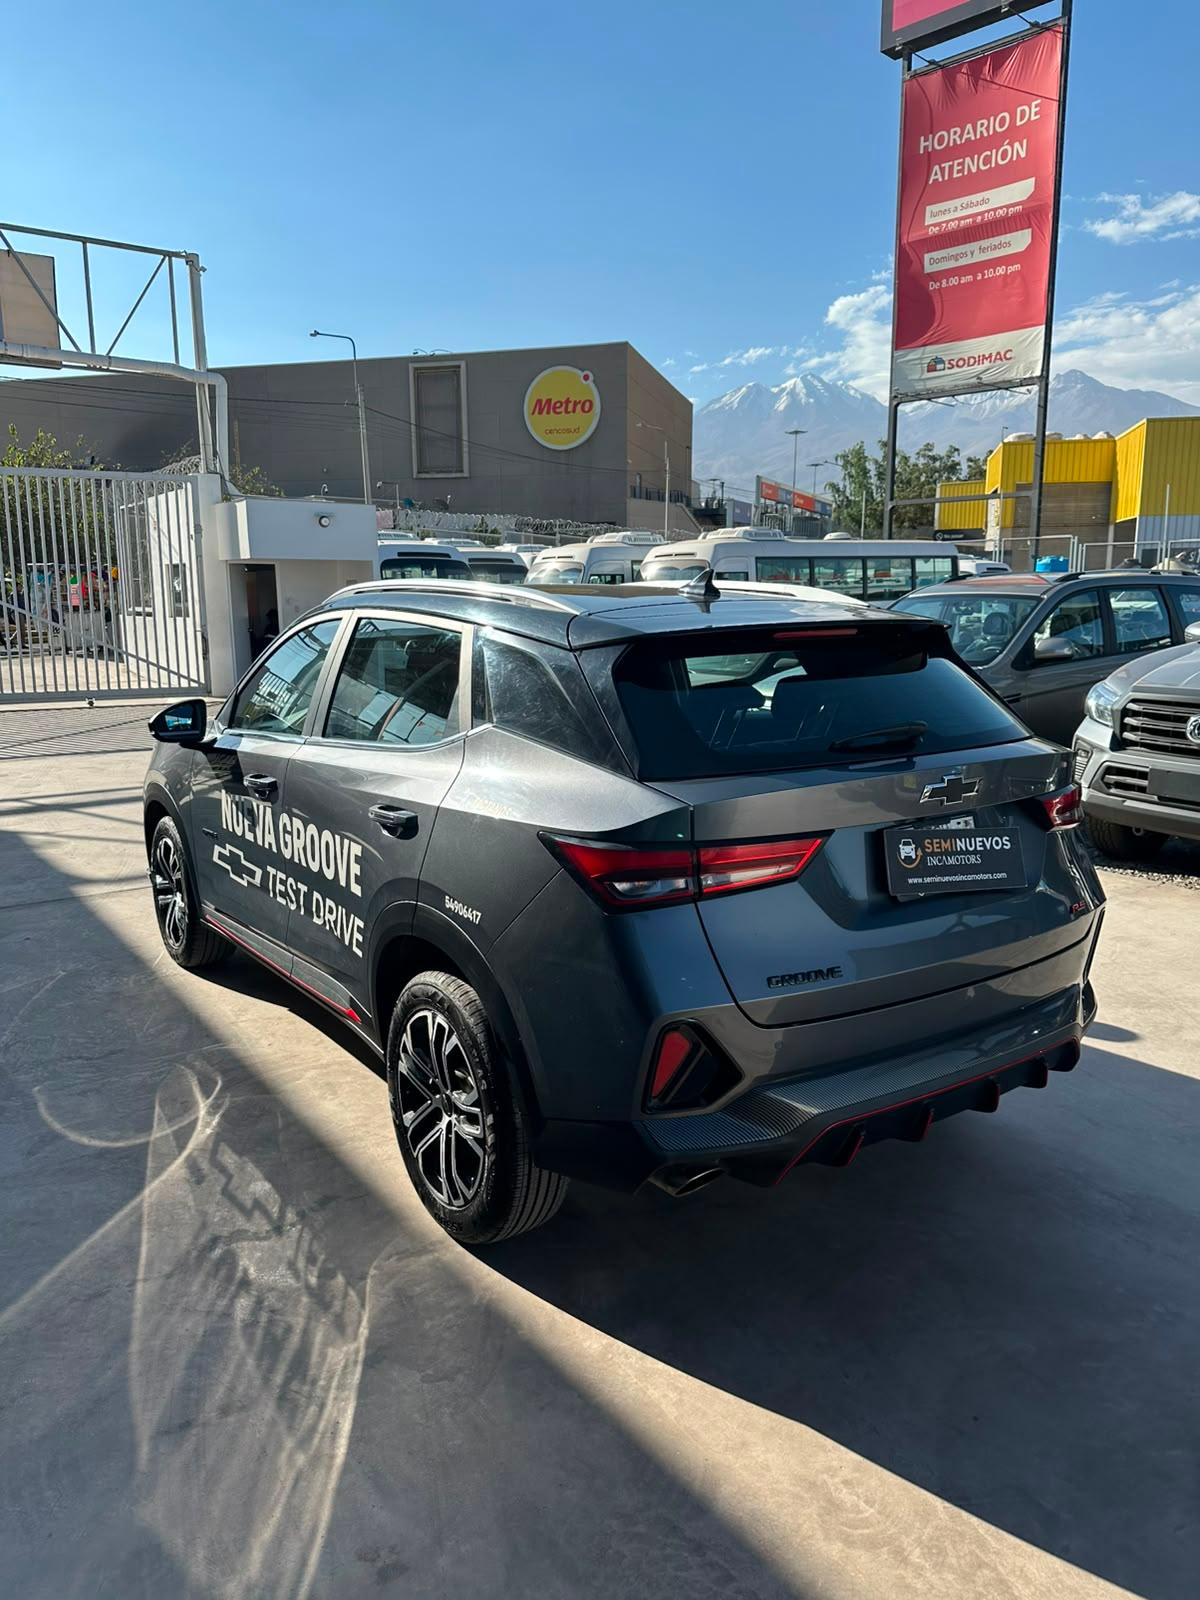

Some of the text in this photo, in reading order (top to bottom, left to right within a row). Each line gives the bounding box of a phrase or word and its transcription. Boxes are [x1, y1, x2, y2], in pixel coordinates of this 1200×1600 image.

[919, 99, 1041, 154] HORARIO DE
[928, 138, 1028, 185] ATENCIÓN
[928, 204, 1023, 235] De 7.00 am a 10.00 pm
[929, 207, 951, 219] lunes
[959, 196, 990, 211] Sábado
[928, 240, 1012, 266] Domingos y feriados
[928, 263, 1021, 291] De 8.00 am a 10.00 pm
[947, 348, 1013, 370] SODIMAC
[531, 397, 594, 416] Metro
[544, 427, 580, 435] cencosud
[221, 789, 362, 897] NUEVA GROOVE
[924, 836, 1012, 853] SEMINUEVOS
[927, 854, 982, 866] INCAMOTORS
[907, 872, 1008, 885] www.seminuevosincamotors.com
[266, 865, 365, 958] TEST DRIVE
[444, 895, 482, 925] 54906417
[766, 965, 843, 988] GROOVE
